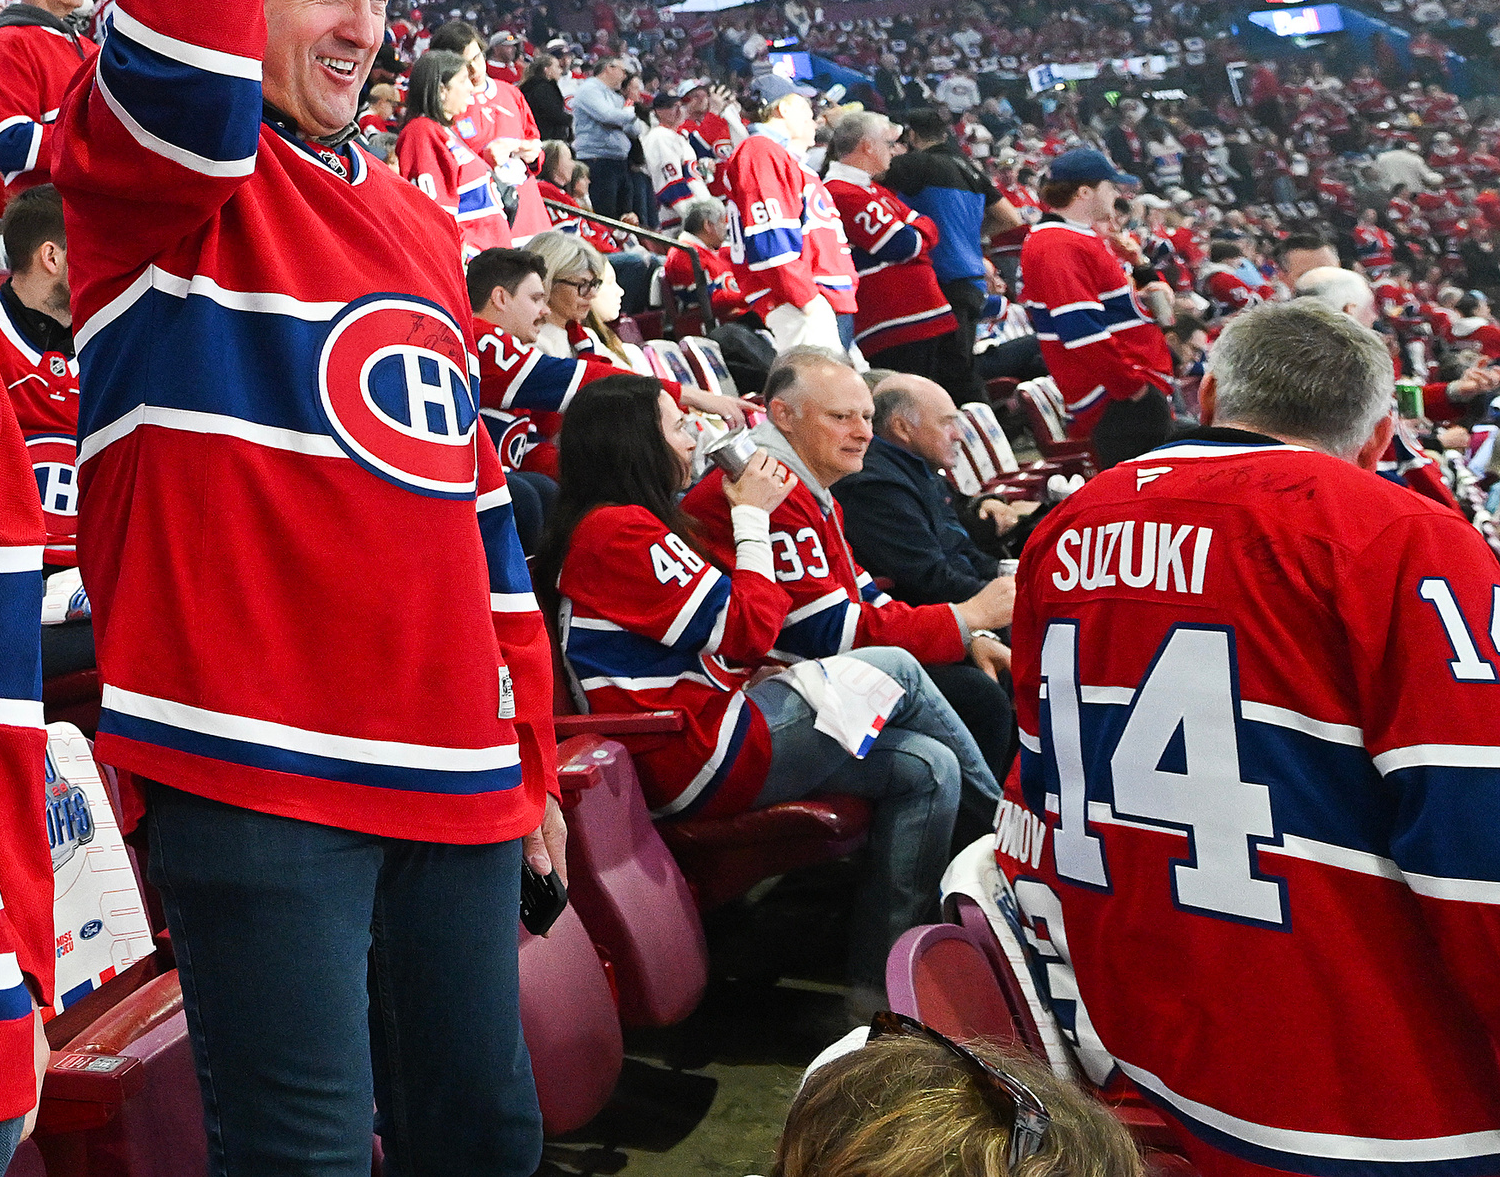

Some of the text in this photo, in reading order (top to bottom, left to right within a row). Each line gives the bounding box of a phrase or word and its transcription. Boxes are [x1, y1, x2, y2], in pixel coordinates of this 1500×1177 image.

[750, 197, 784, 225] 60
[649, 531, 706, 588] 48
[769, 526, 830, 582] 33
[1051, 520, 1214, 595] SUZUKI
[1417, 576, 1500, 684] 1
[1040, 618, 1293, 933] 14
[56, 930, 73, 947] MISE
